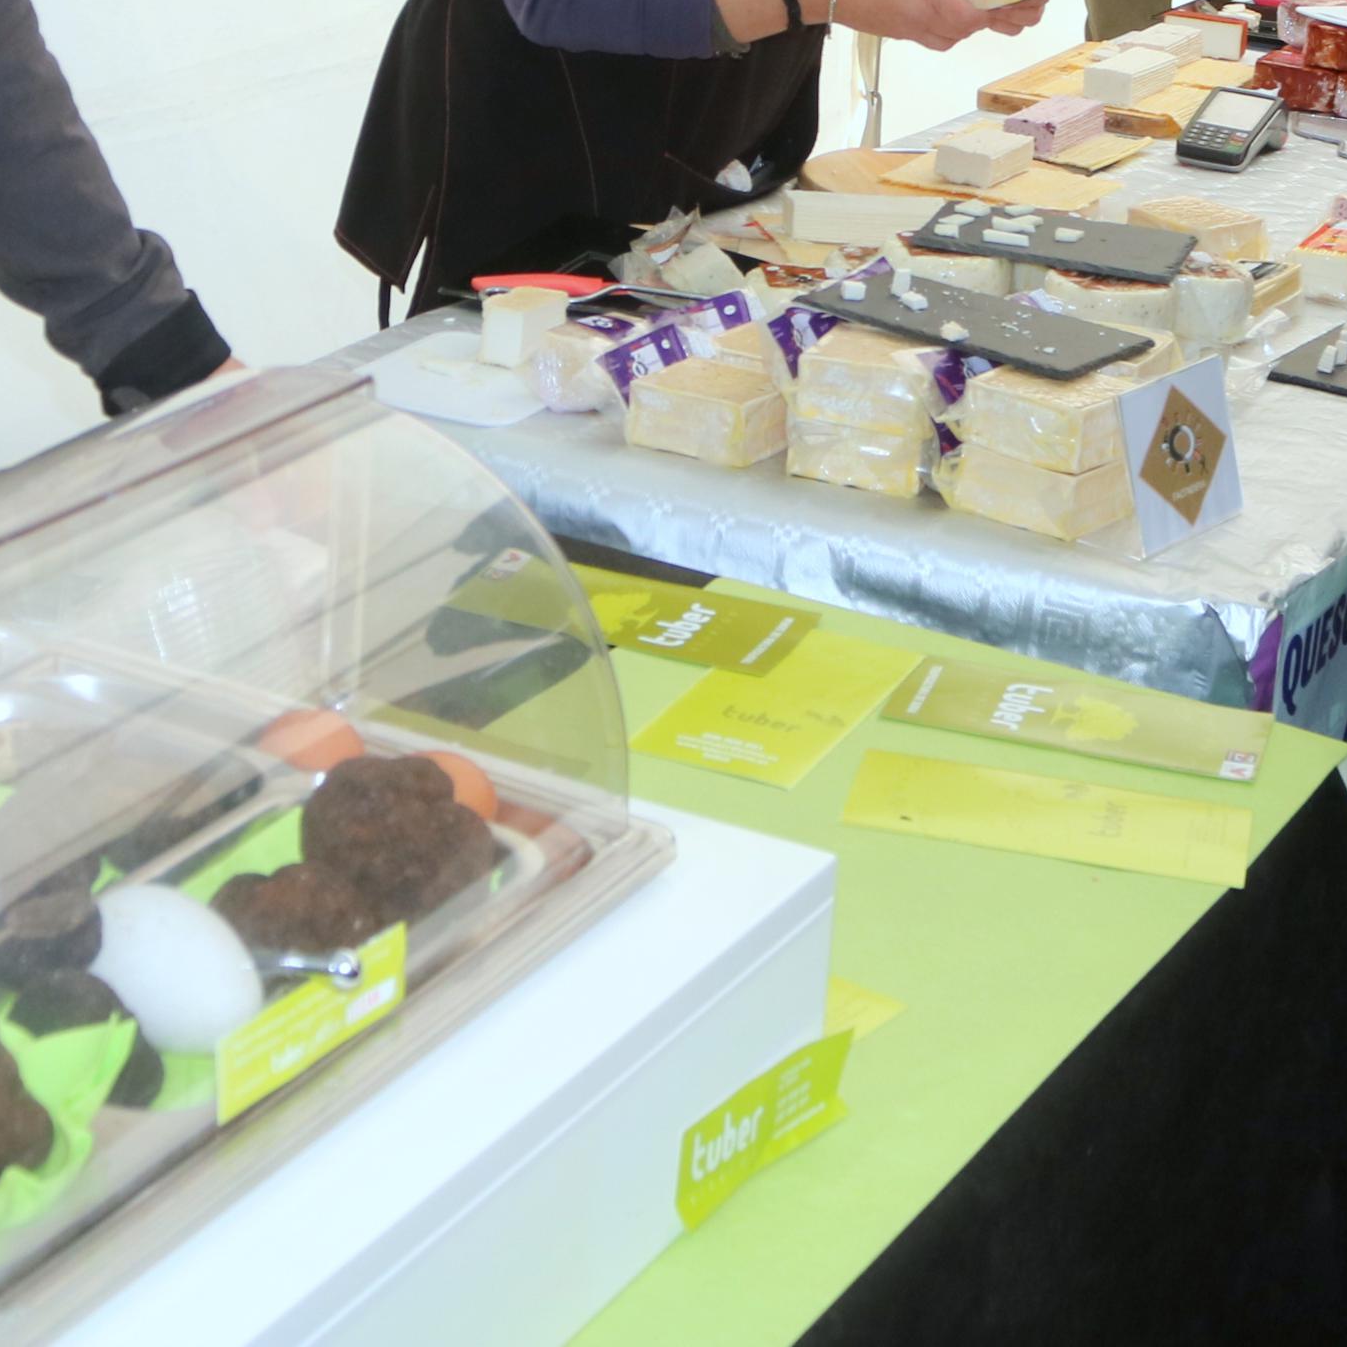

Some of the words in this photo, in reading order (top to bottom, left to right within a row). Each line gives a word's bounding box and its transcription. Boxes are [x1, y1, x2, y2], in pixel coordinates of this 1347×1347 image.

[637, 601, 717, 648] tuber
[721, 704, 802, 734] tuber
[989, 681, 1055, 733] tuber
[690, 1104, 765, 1184] tuber
